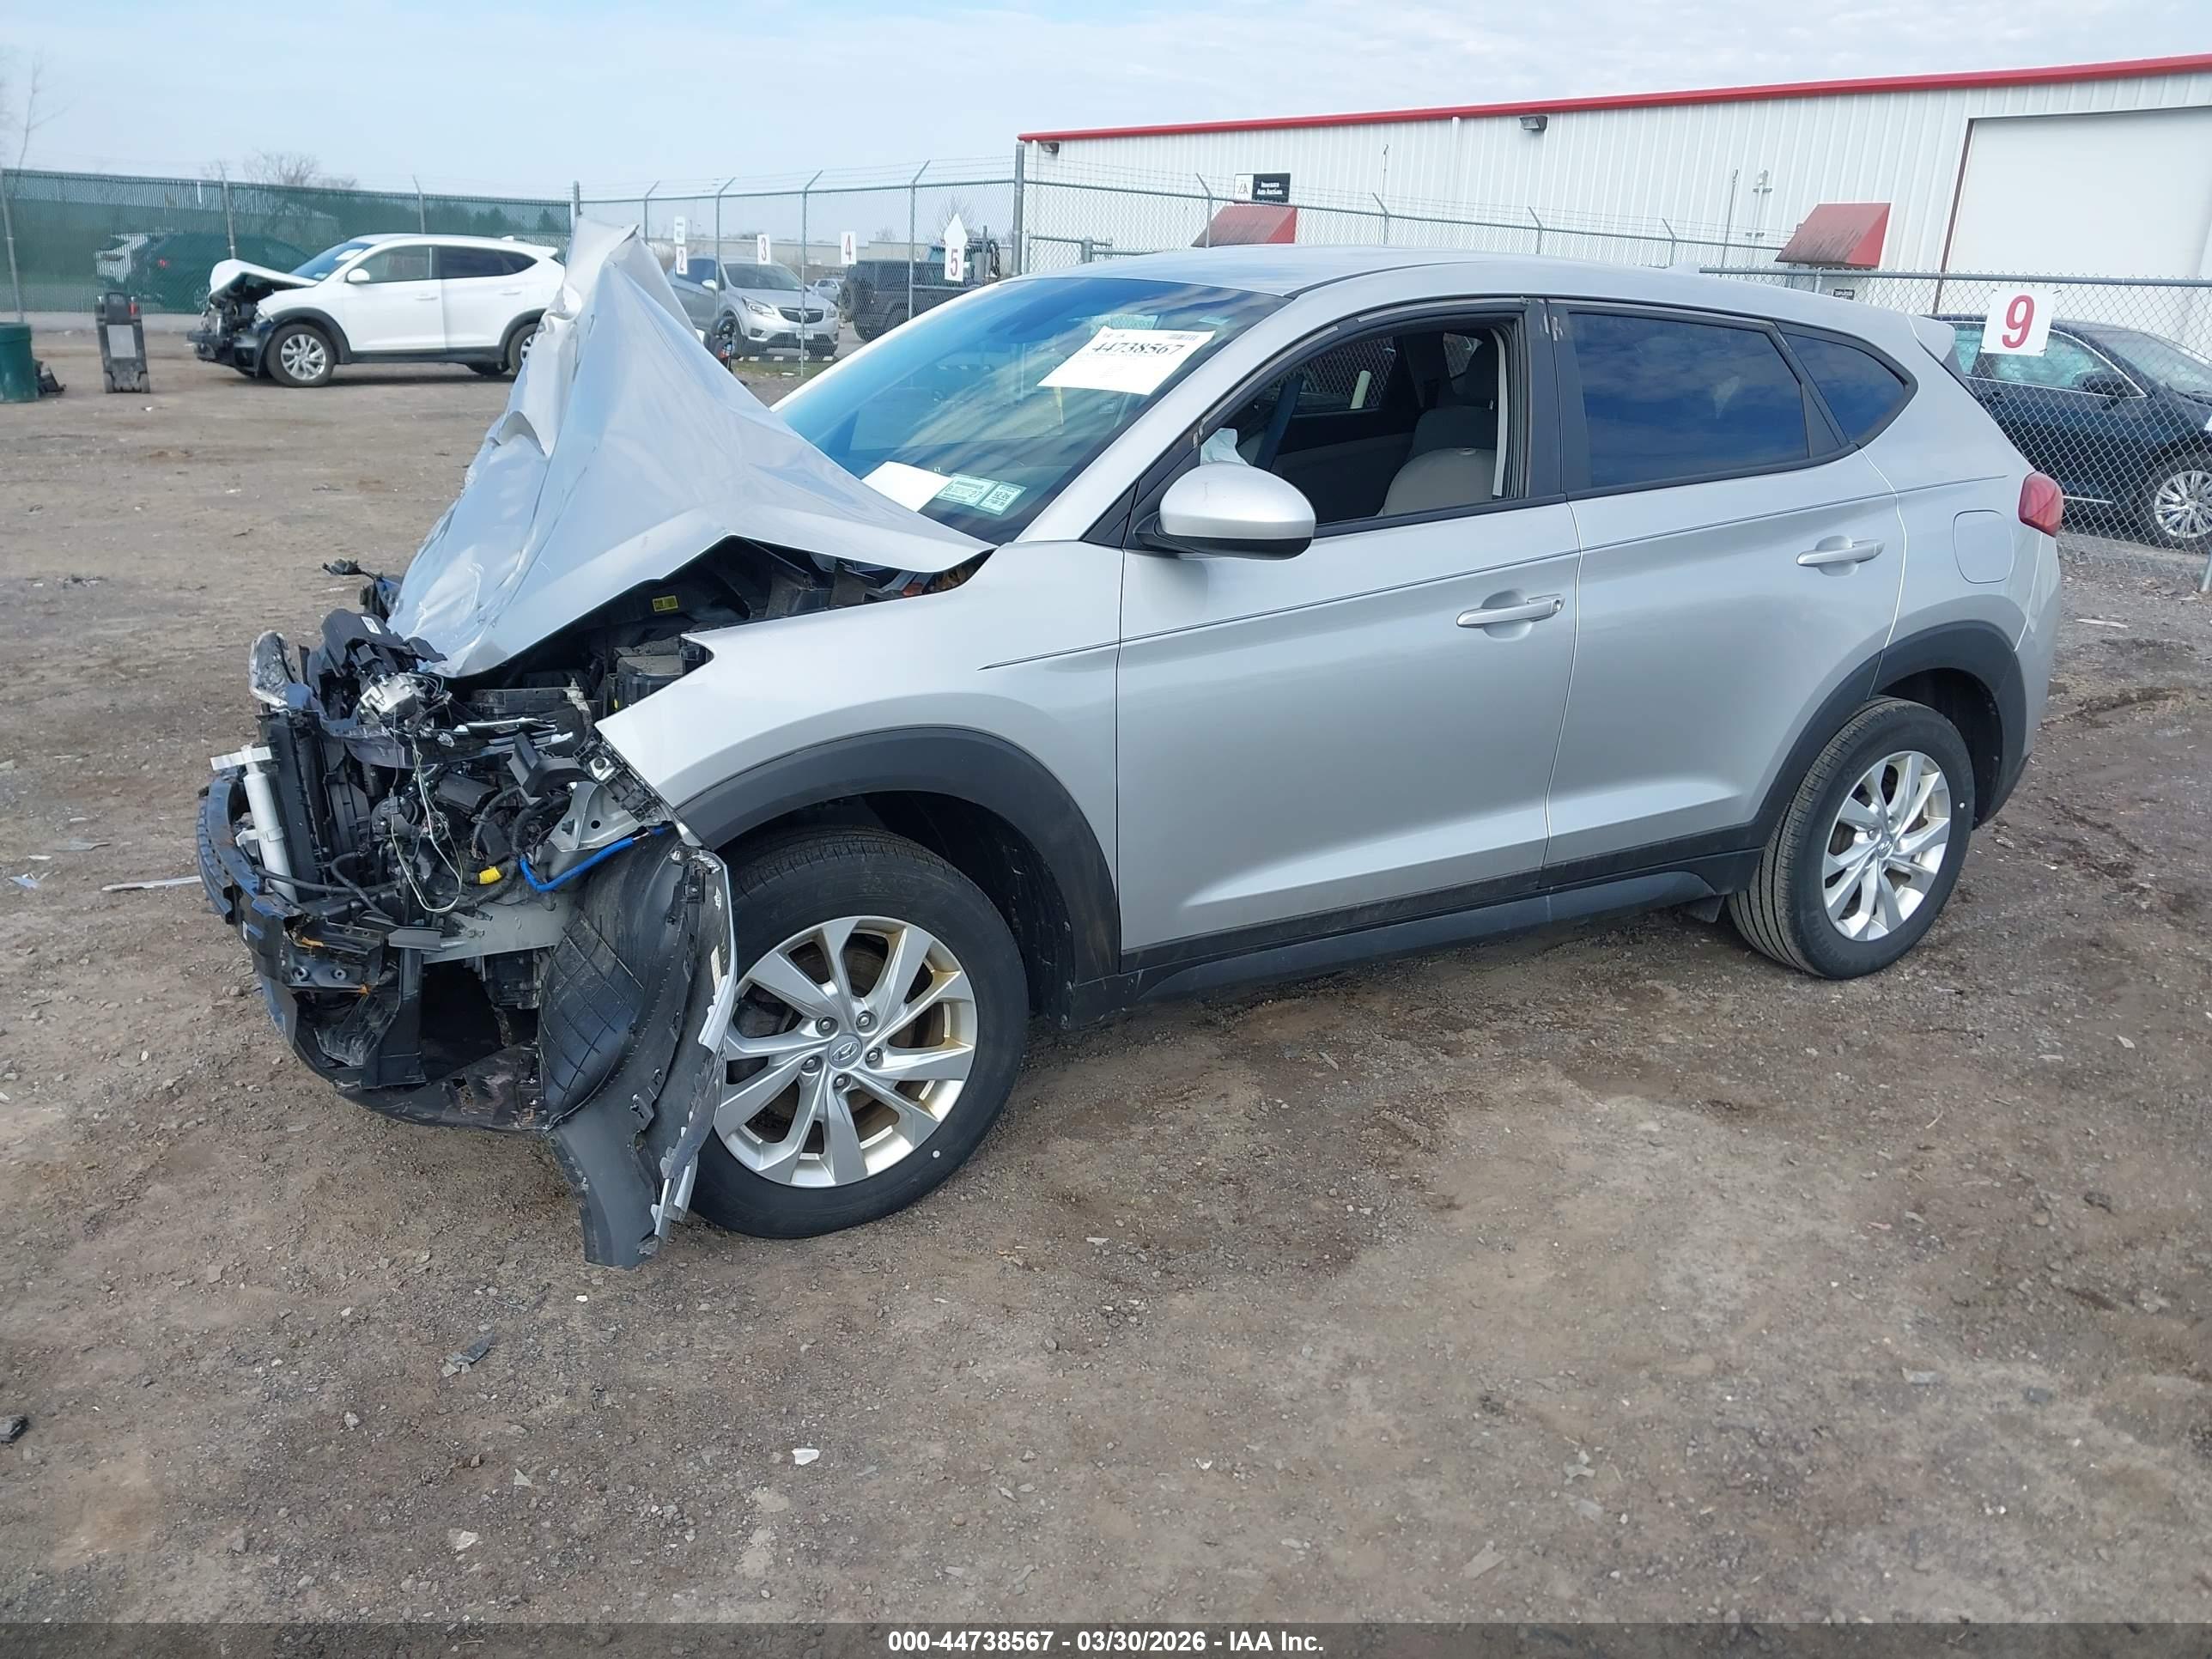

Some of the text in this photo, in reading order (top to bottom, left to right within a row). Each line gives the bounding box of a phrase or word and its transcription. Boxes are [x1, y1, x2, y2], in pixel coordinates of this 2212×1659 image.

[761, 236, 767, 262] 3
[845, 233, 853, 262] 4
[950, 247, 959, 276] 5
[2002, 294, 2035, 349] 9
[1092, 342, 1185, 356] 44738567
